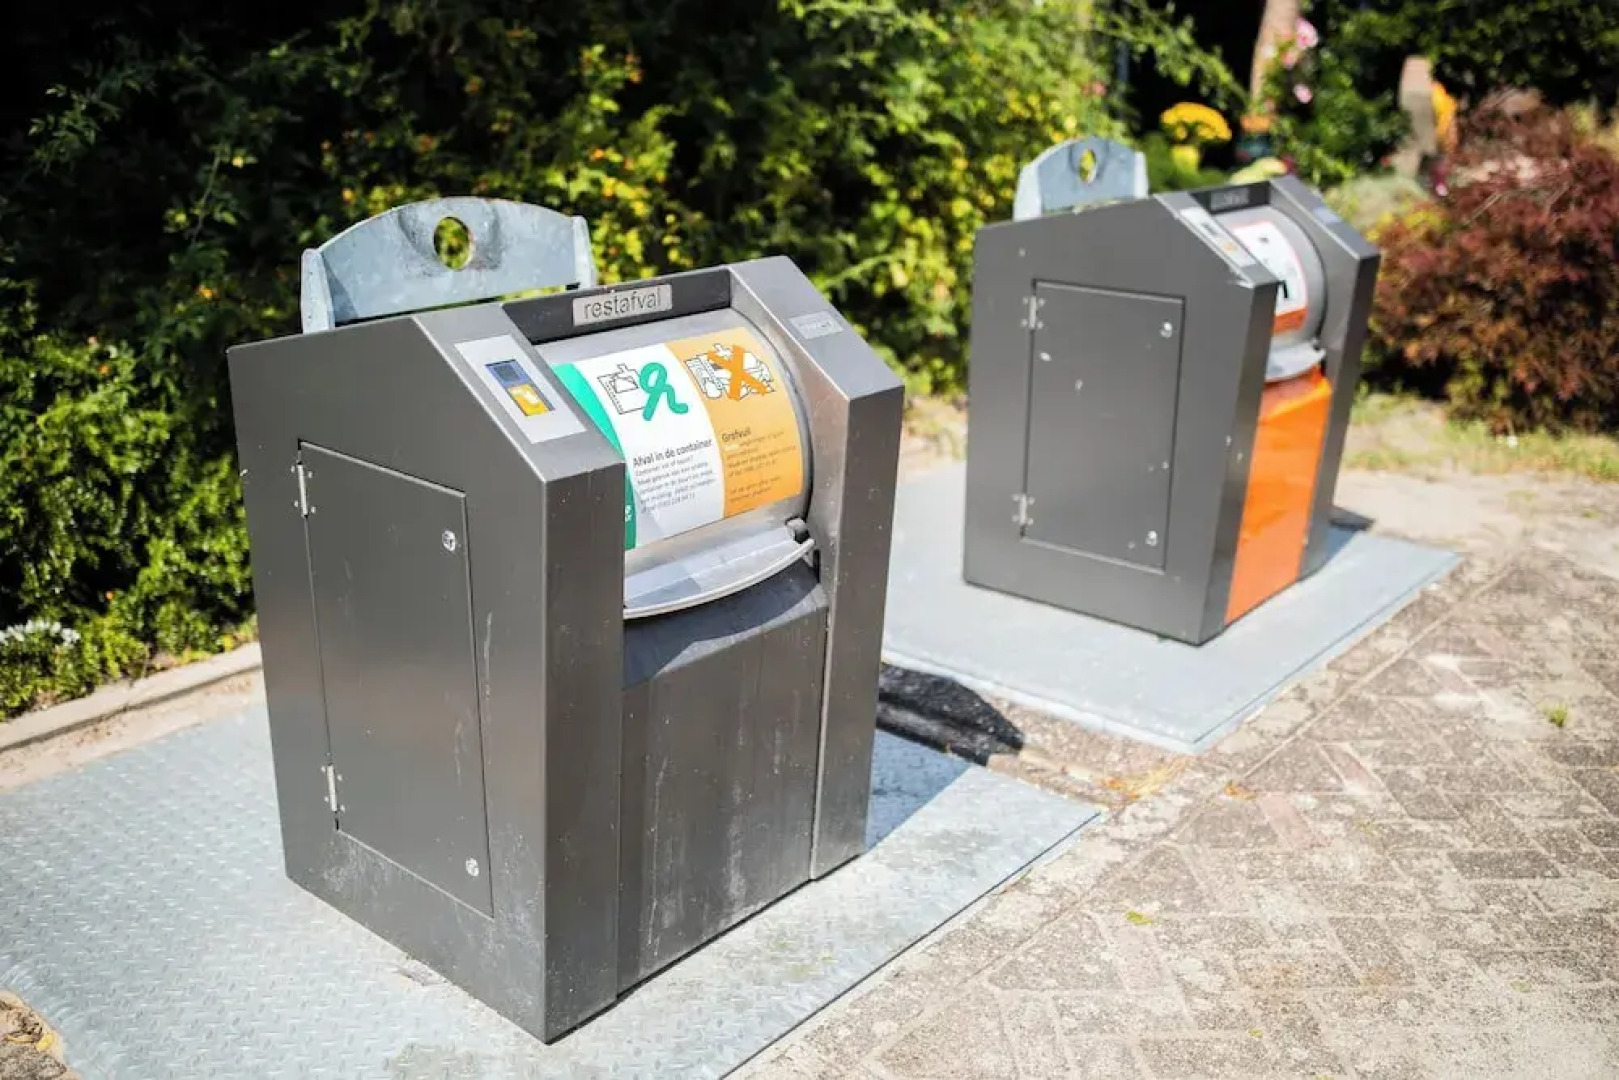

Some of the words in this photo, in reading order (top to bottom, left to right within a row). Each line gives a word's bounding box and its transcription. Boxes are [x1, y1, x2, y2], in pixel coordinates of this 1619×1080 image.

[583, 287, 661, 320] restafval
[633, 452, 655, 467] Afval
[655, 451, 664, 461] in
[665, 447, 675, 459] de
[676, 439, 712, 455] container
